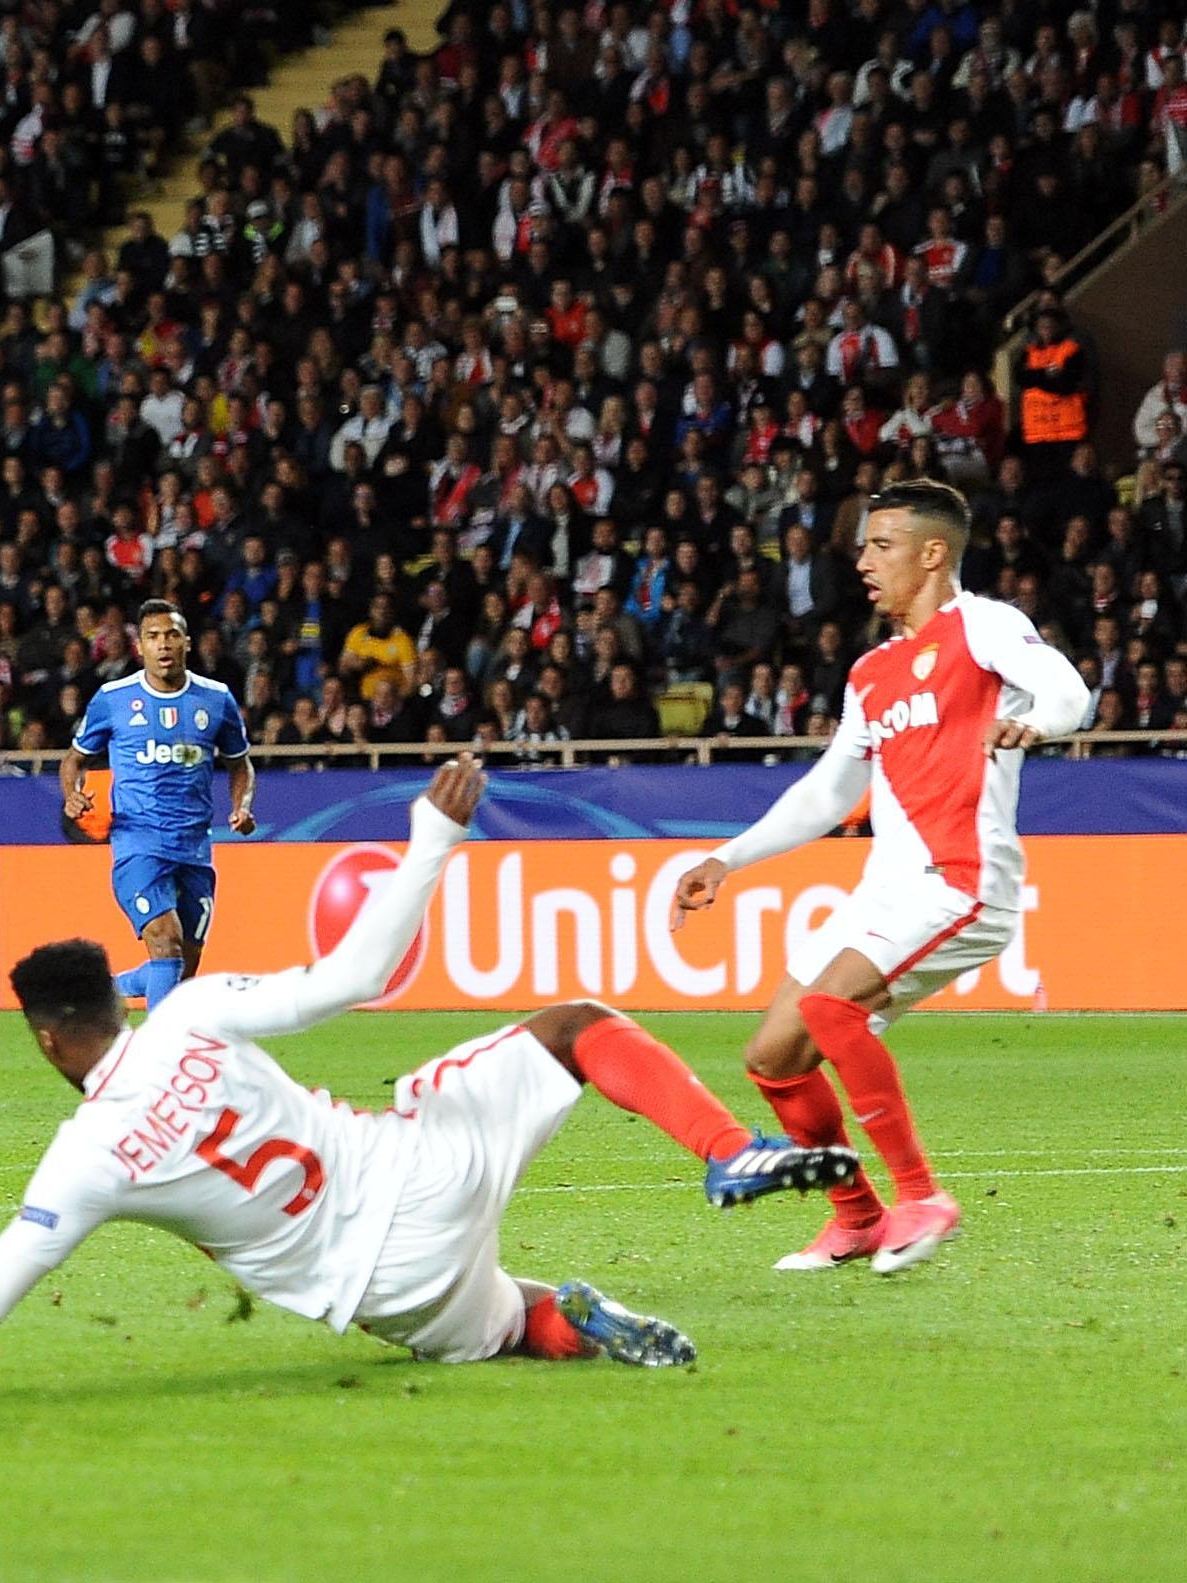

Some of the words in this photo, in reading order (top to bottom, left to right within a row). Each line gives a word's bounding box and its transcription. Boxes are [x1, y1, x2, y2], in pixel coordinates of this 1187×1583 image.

[136, 739, 203, 767] Jeep
[443, 850, 1039, 996] UniCret
[196, 1106, 326, 1217] 5
